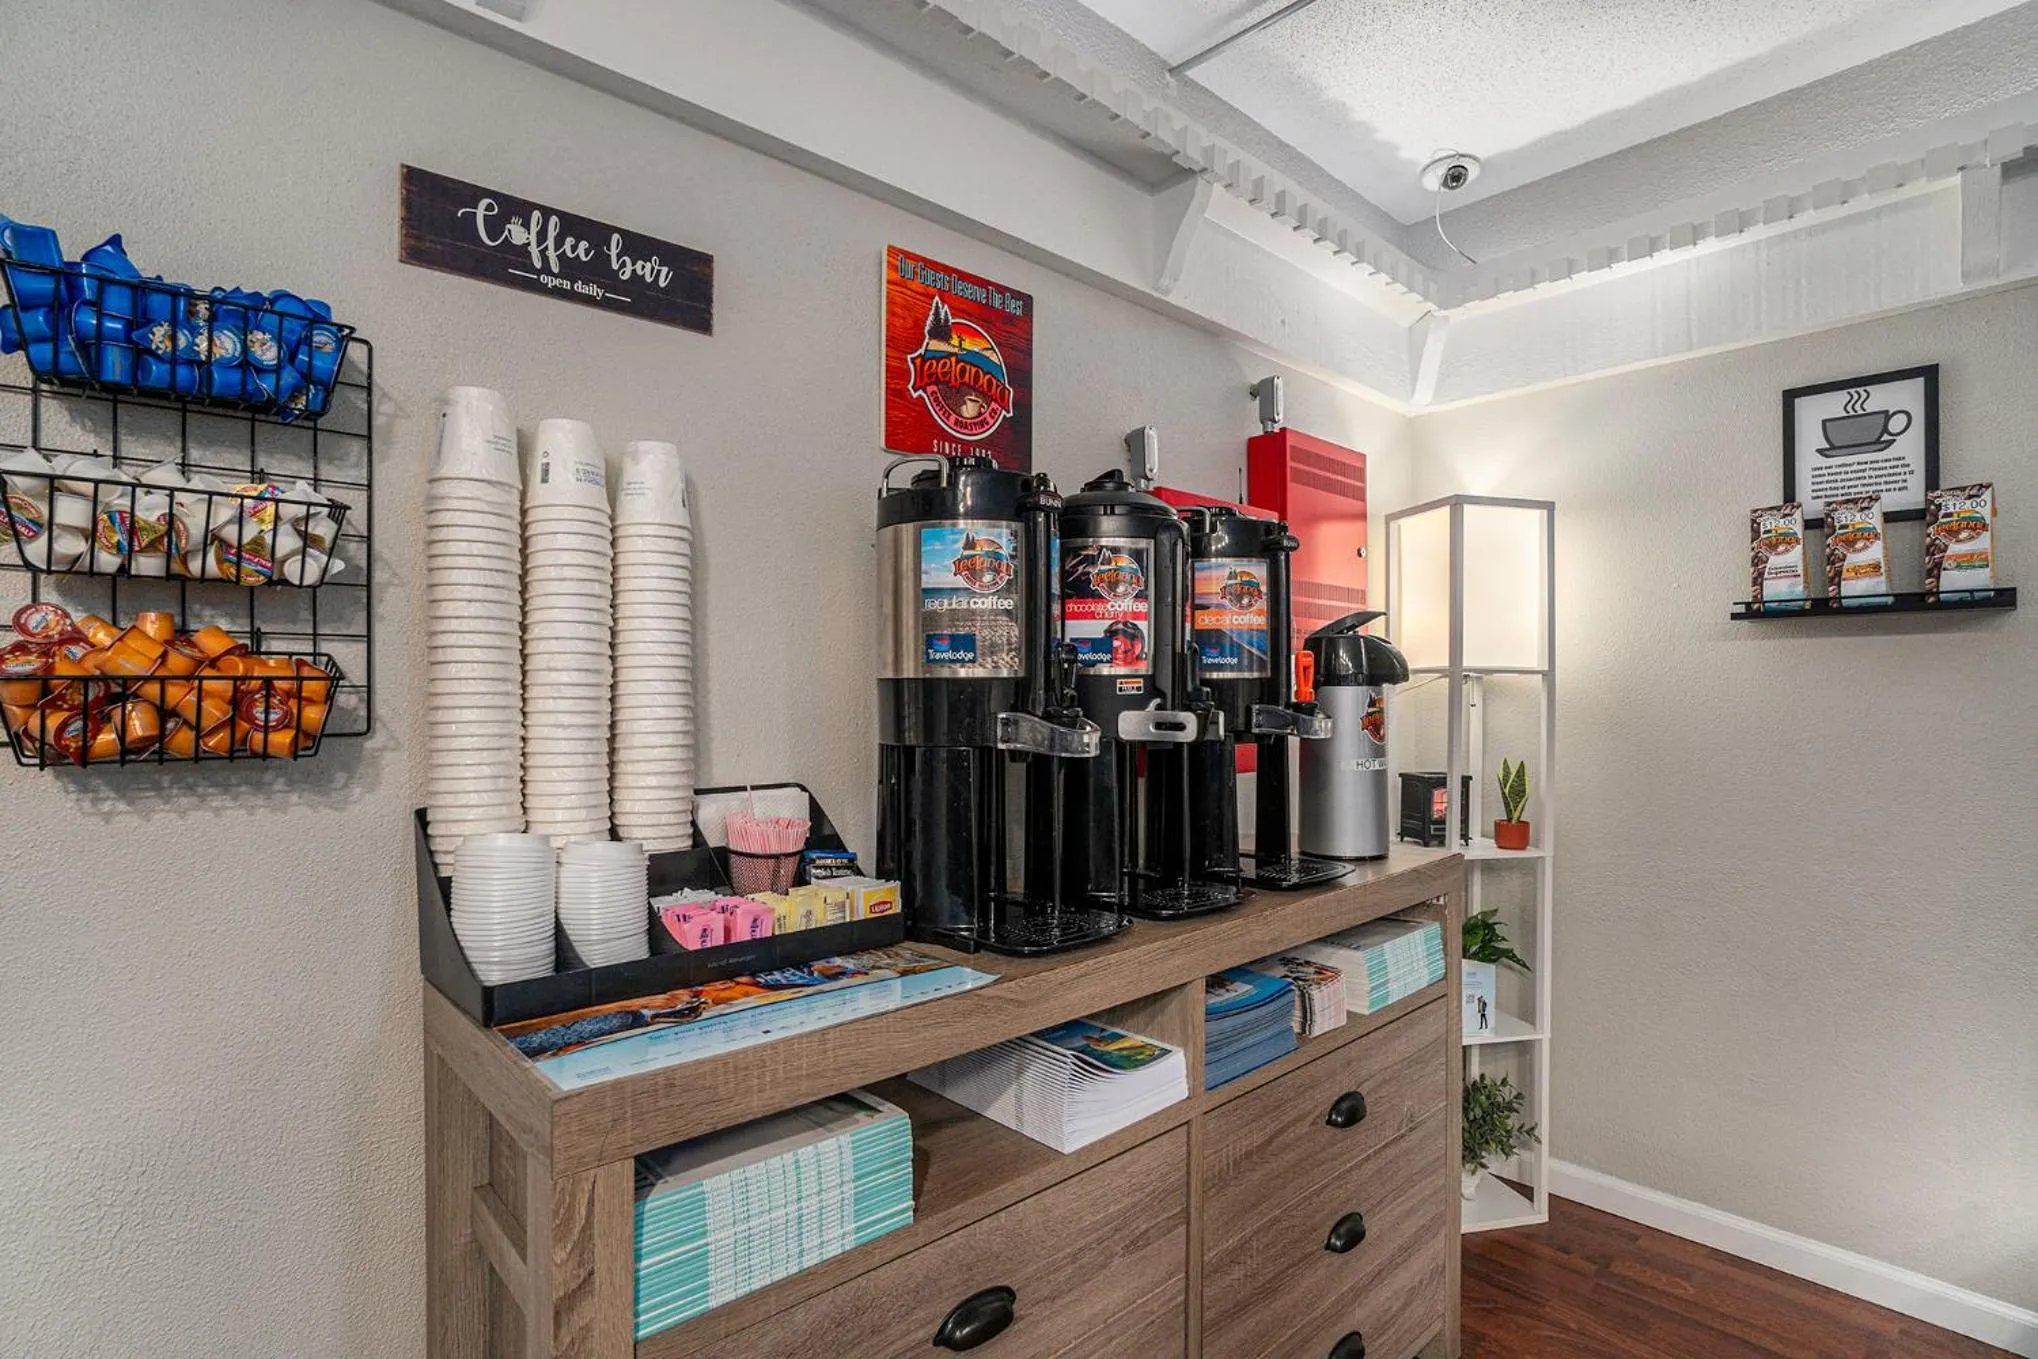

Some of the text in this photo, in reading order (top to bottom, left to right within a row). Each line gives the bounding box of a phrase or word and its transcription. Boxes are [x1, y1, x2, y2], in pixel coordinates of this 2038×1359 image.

[457, 198, 674, 288] Coffee bar
[540, 273, 605, 300] open daily
[898, 254, 1024, 317] Our Guests Deserve The Best
[912, 356, 1011, 410] Leelanau
[953, 416, 990, 432] ROASTING
[932, 439, 962, 457] SINCE
[1942, 499, 1987, 511] $12.00
[1762, 518, 1797, 529] $12.00
[1836, 511, 1874, 524] $12.00
[924, 596, 1014, 612] regular coffee
[1108, 599, 1148, 612] coffee
[1232, 614, 1266, 625] coffee
[927, 649, 975, 661] Travelodge
[1201, 655, 1239, 665] Travelodge
[1356, 760, 1376, 770] HOT
